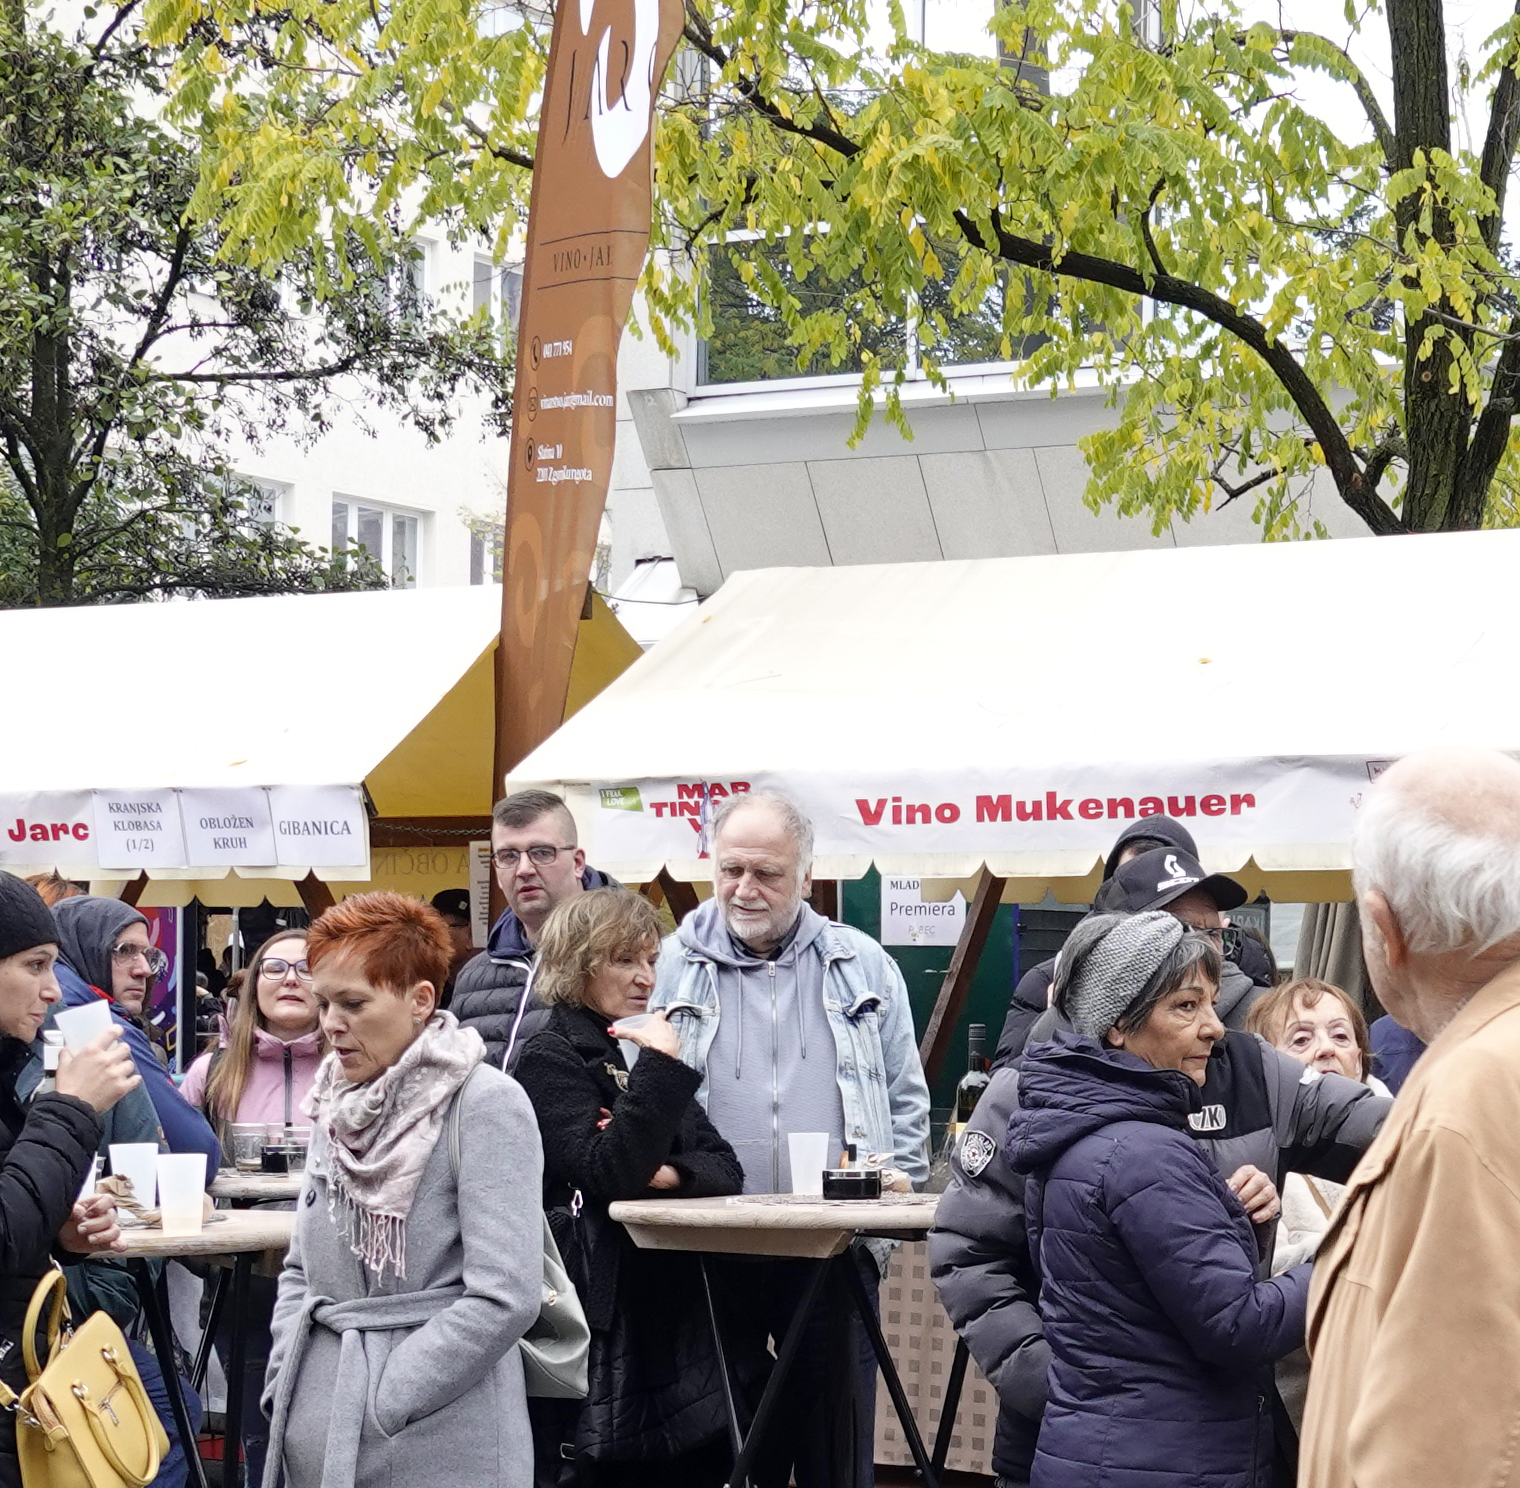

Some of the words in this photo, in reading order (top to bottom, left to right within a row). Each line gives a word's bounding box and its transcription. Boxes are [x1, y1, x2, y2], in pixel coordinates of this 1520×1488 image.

[108, 801, 163, 815] KRANJSKA
[650, 800, 722, 818] TIN
[855, 796, 961, 826] Vino
[976, 791, 1257, 823] Mukenauer
[113, 820, 163, 832] KLOBASA
[199, 814, 255, 831] OBLOŽEN
[279, 820, 352, 836] GIBANICA
[8, 818, 90, 843] Jarc
[126, 838, 155, 852] (1/2)
[213, 836, 248, 850] KRUH
[890, 901, 956, 916] Premiera
